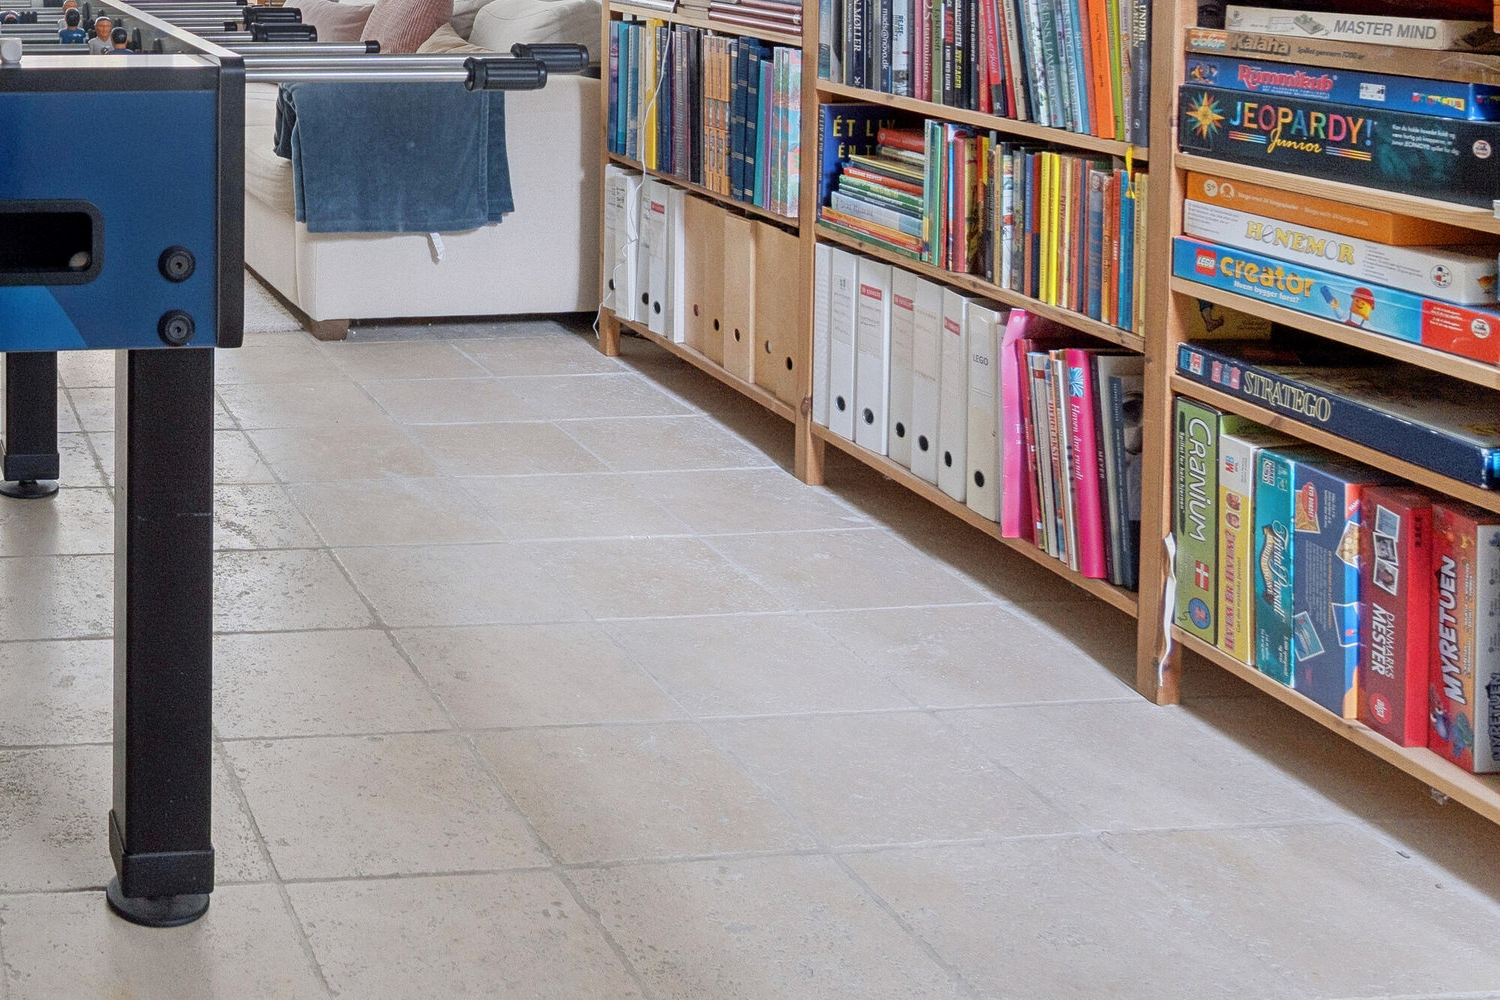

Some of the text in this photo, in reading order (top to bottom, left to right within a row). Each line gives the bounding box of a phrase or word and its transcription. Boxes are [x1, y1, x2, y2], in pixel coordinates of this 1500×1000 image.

[924, 0, 933, 21] 25
[1064, 28, 1074, 52] BOG
[1334, 19, 1438, 40] MASTER MIND
[1232, 34, 1291, 56] Kalaha
[1044, 42, 1056, 107] HAVEBOG
[1067, 54, 1075, 75] OM
[1238, 64, 1334, 90] Rummikub
[833, 115, 855, 136] ÉT
[1230, 101, 1372, 146] JEOPARDY!
[839, 142, 856, 158] ÉN
[1267, 128, 1322, 152] Junior
[1197, 256, 1215, 268] LEGO
[1221, 256, 1315, 296] creator
[1234, 280, 1278, 300] Hvem bygger
[973, 354, 988, 365] LEGO
[1244, 371, 1331, 422] STRATEGO
[1071, 404, 1083, 480] Haven rundt
[1226, 456, 1234, 473] MB
[1264, 520, 1289, 616] Trivial Pursuit
[1225, 529, 1235, 650] HVEM ER HVEM?
[1371, 603, 1385, 676] MESTER
[1439, 554, 1467, 704] MYRETUEN
[1386, 612, 1395, 678] DANMARKS
[1375, 700, 1386, 718] alga
